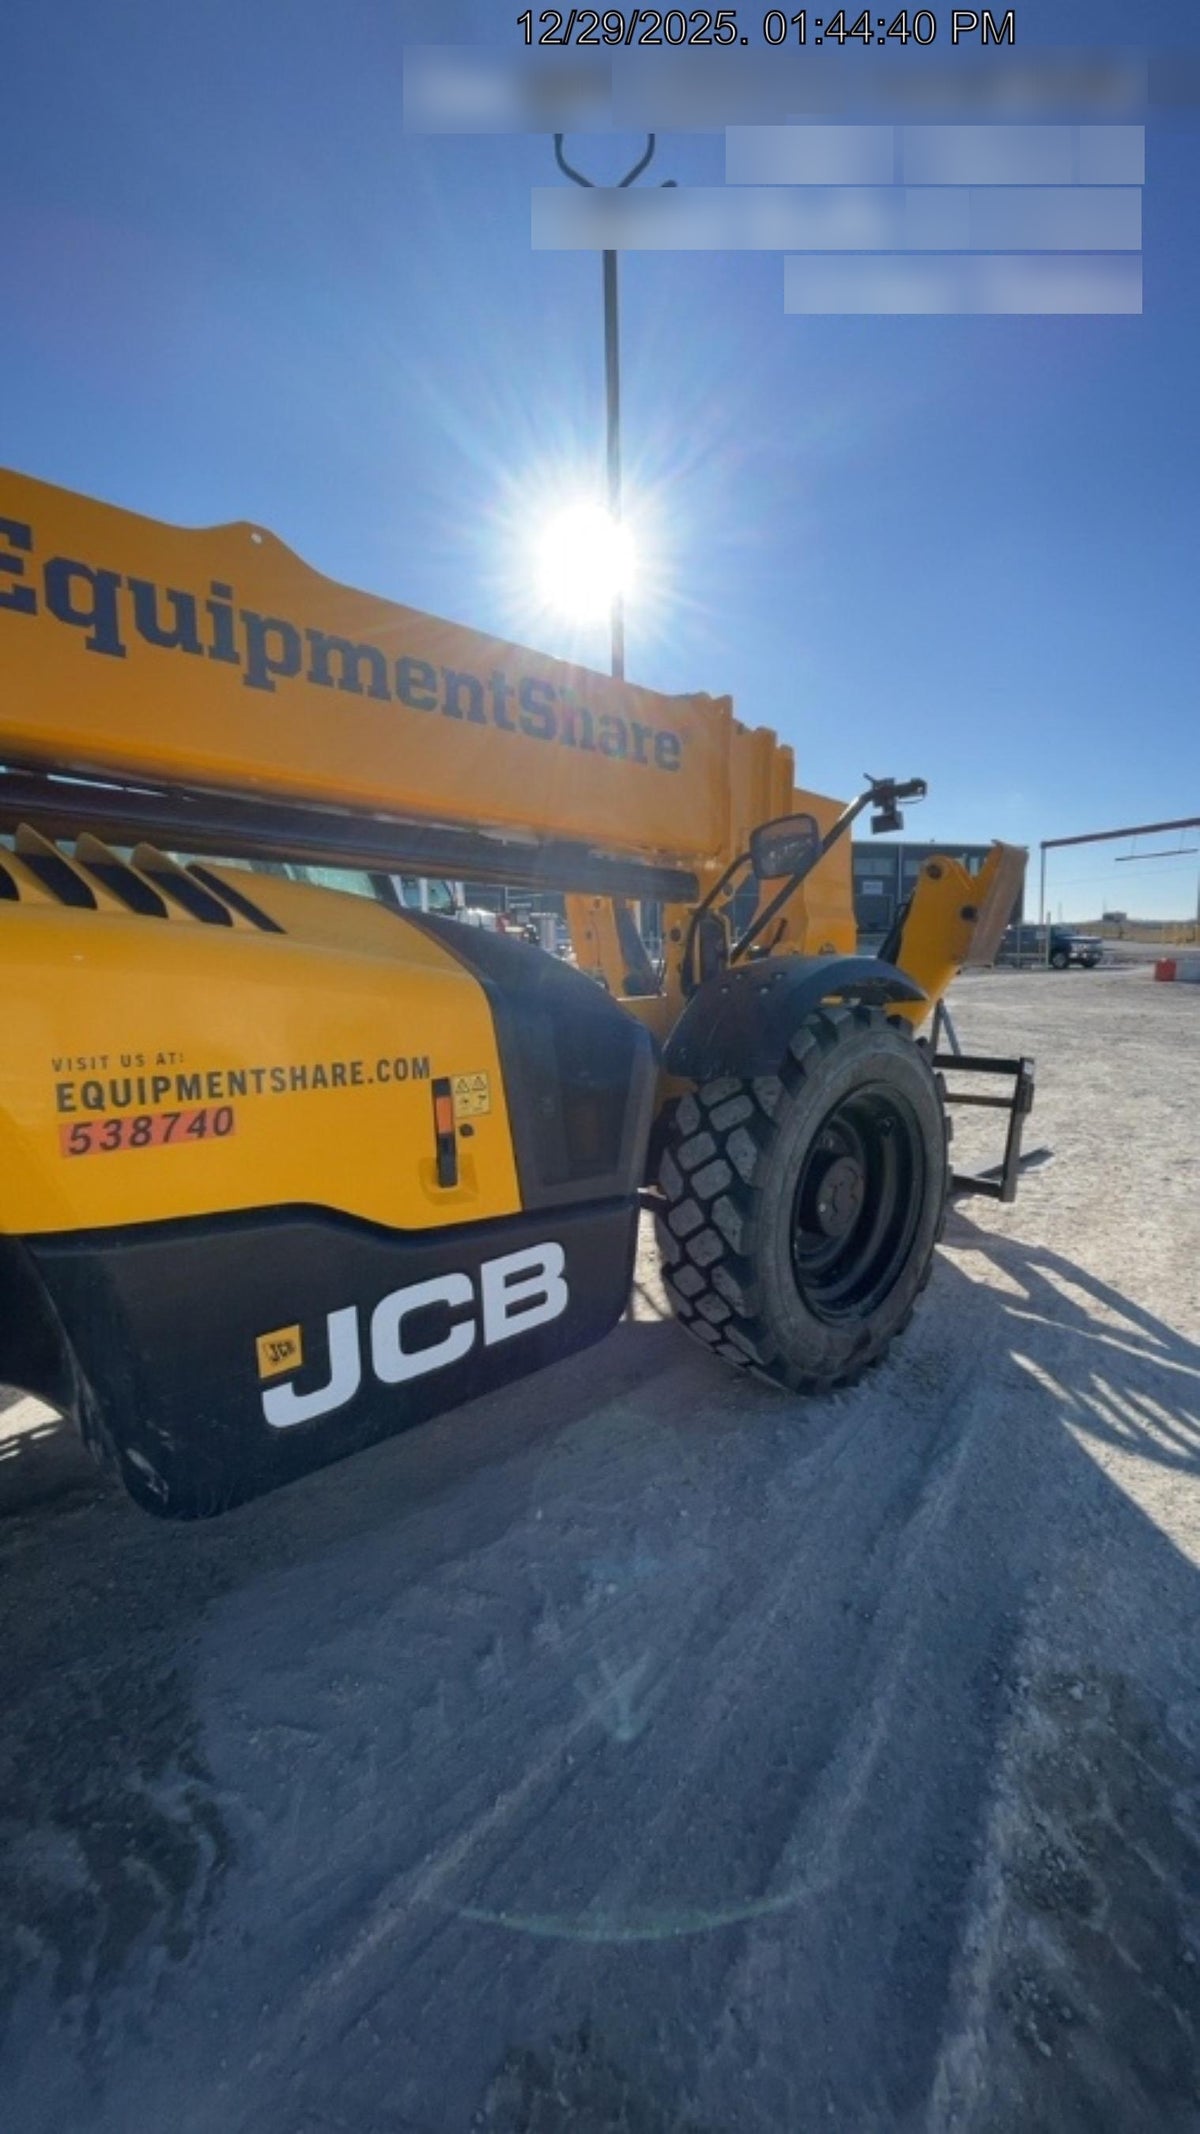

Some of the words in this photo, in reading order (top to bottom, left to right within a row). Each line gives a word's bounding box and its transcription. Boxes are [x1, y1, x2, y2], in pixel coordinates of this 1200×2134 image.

[51, 1055, 109, 1072] VISIT
[120, 1053, 145, 1068] US
[156, 1052, 184, 1065] AT:
[56, 1056, 431, 1113] EQUIPMENTSHARE.COM
[68, 1105, 234, 1156] 538740
[261, 1241, 568, 1429] JCB
